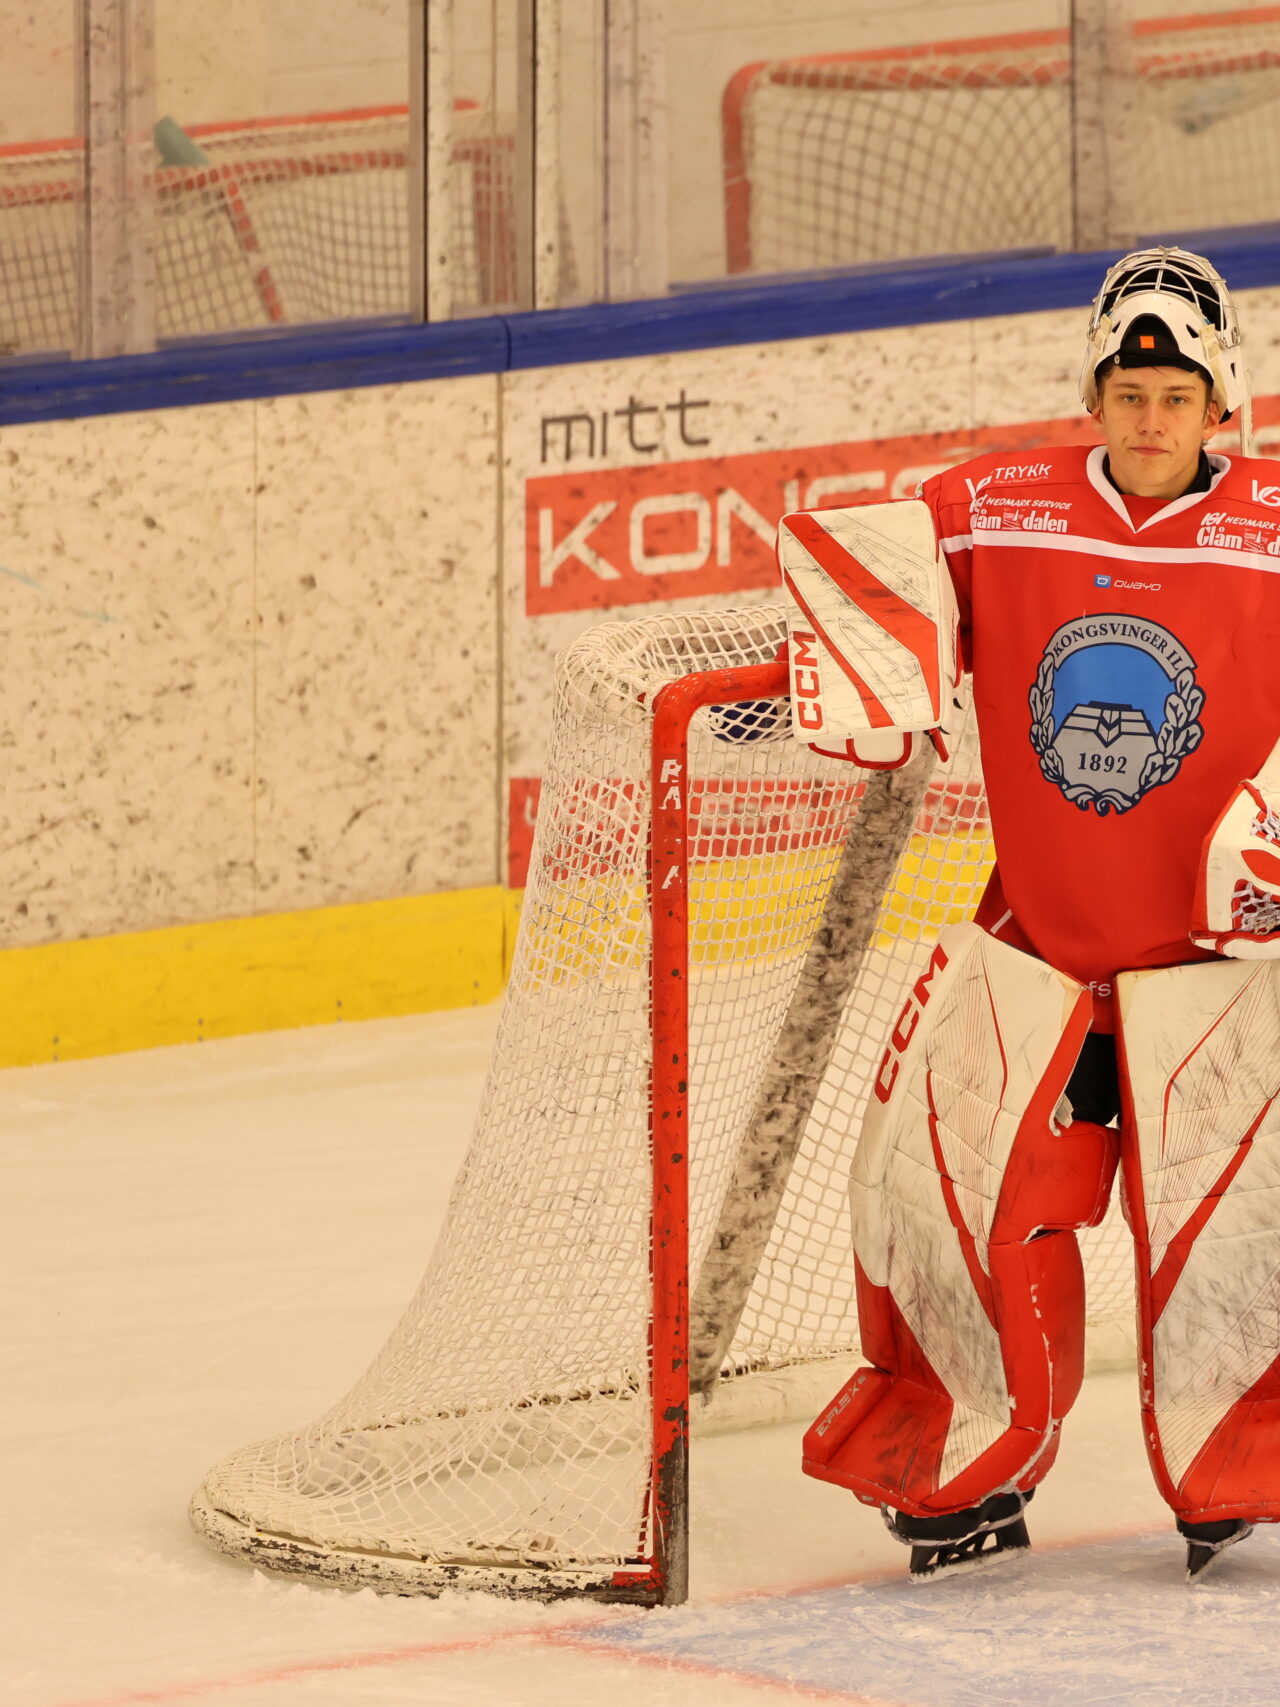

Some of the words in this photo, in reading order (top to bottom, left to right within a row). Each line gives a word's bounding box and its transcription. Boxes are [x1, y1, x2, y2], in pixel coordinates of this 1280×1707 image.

[541, 390, 710, 463] mitt
[995, 463, 1052, 480] TRYKK
[986, 497, 1031, 507] HEDMARK
[1032, 499, 1072, 510] SERVICE
[1022, 510, 1068, 533] dalen
[1225, 516, 1276, 530] HEDMARK
[1114, 579, 1162, 592] owayo
[1053, 622, 1167, 658] KONGSVINGER
[1166, 650, 1184, 671] IL
[791, 631, 824, 730] CCM
[1078, 752, 1128, 774] 1892
[874, 943, 949, 1104] CCM
